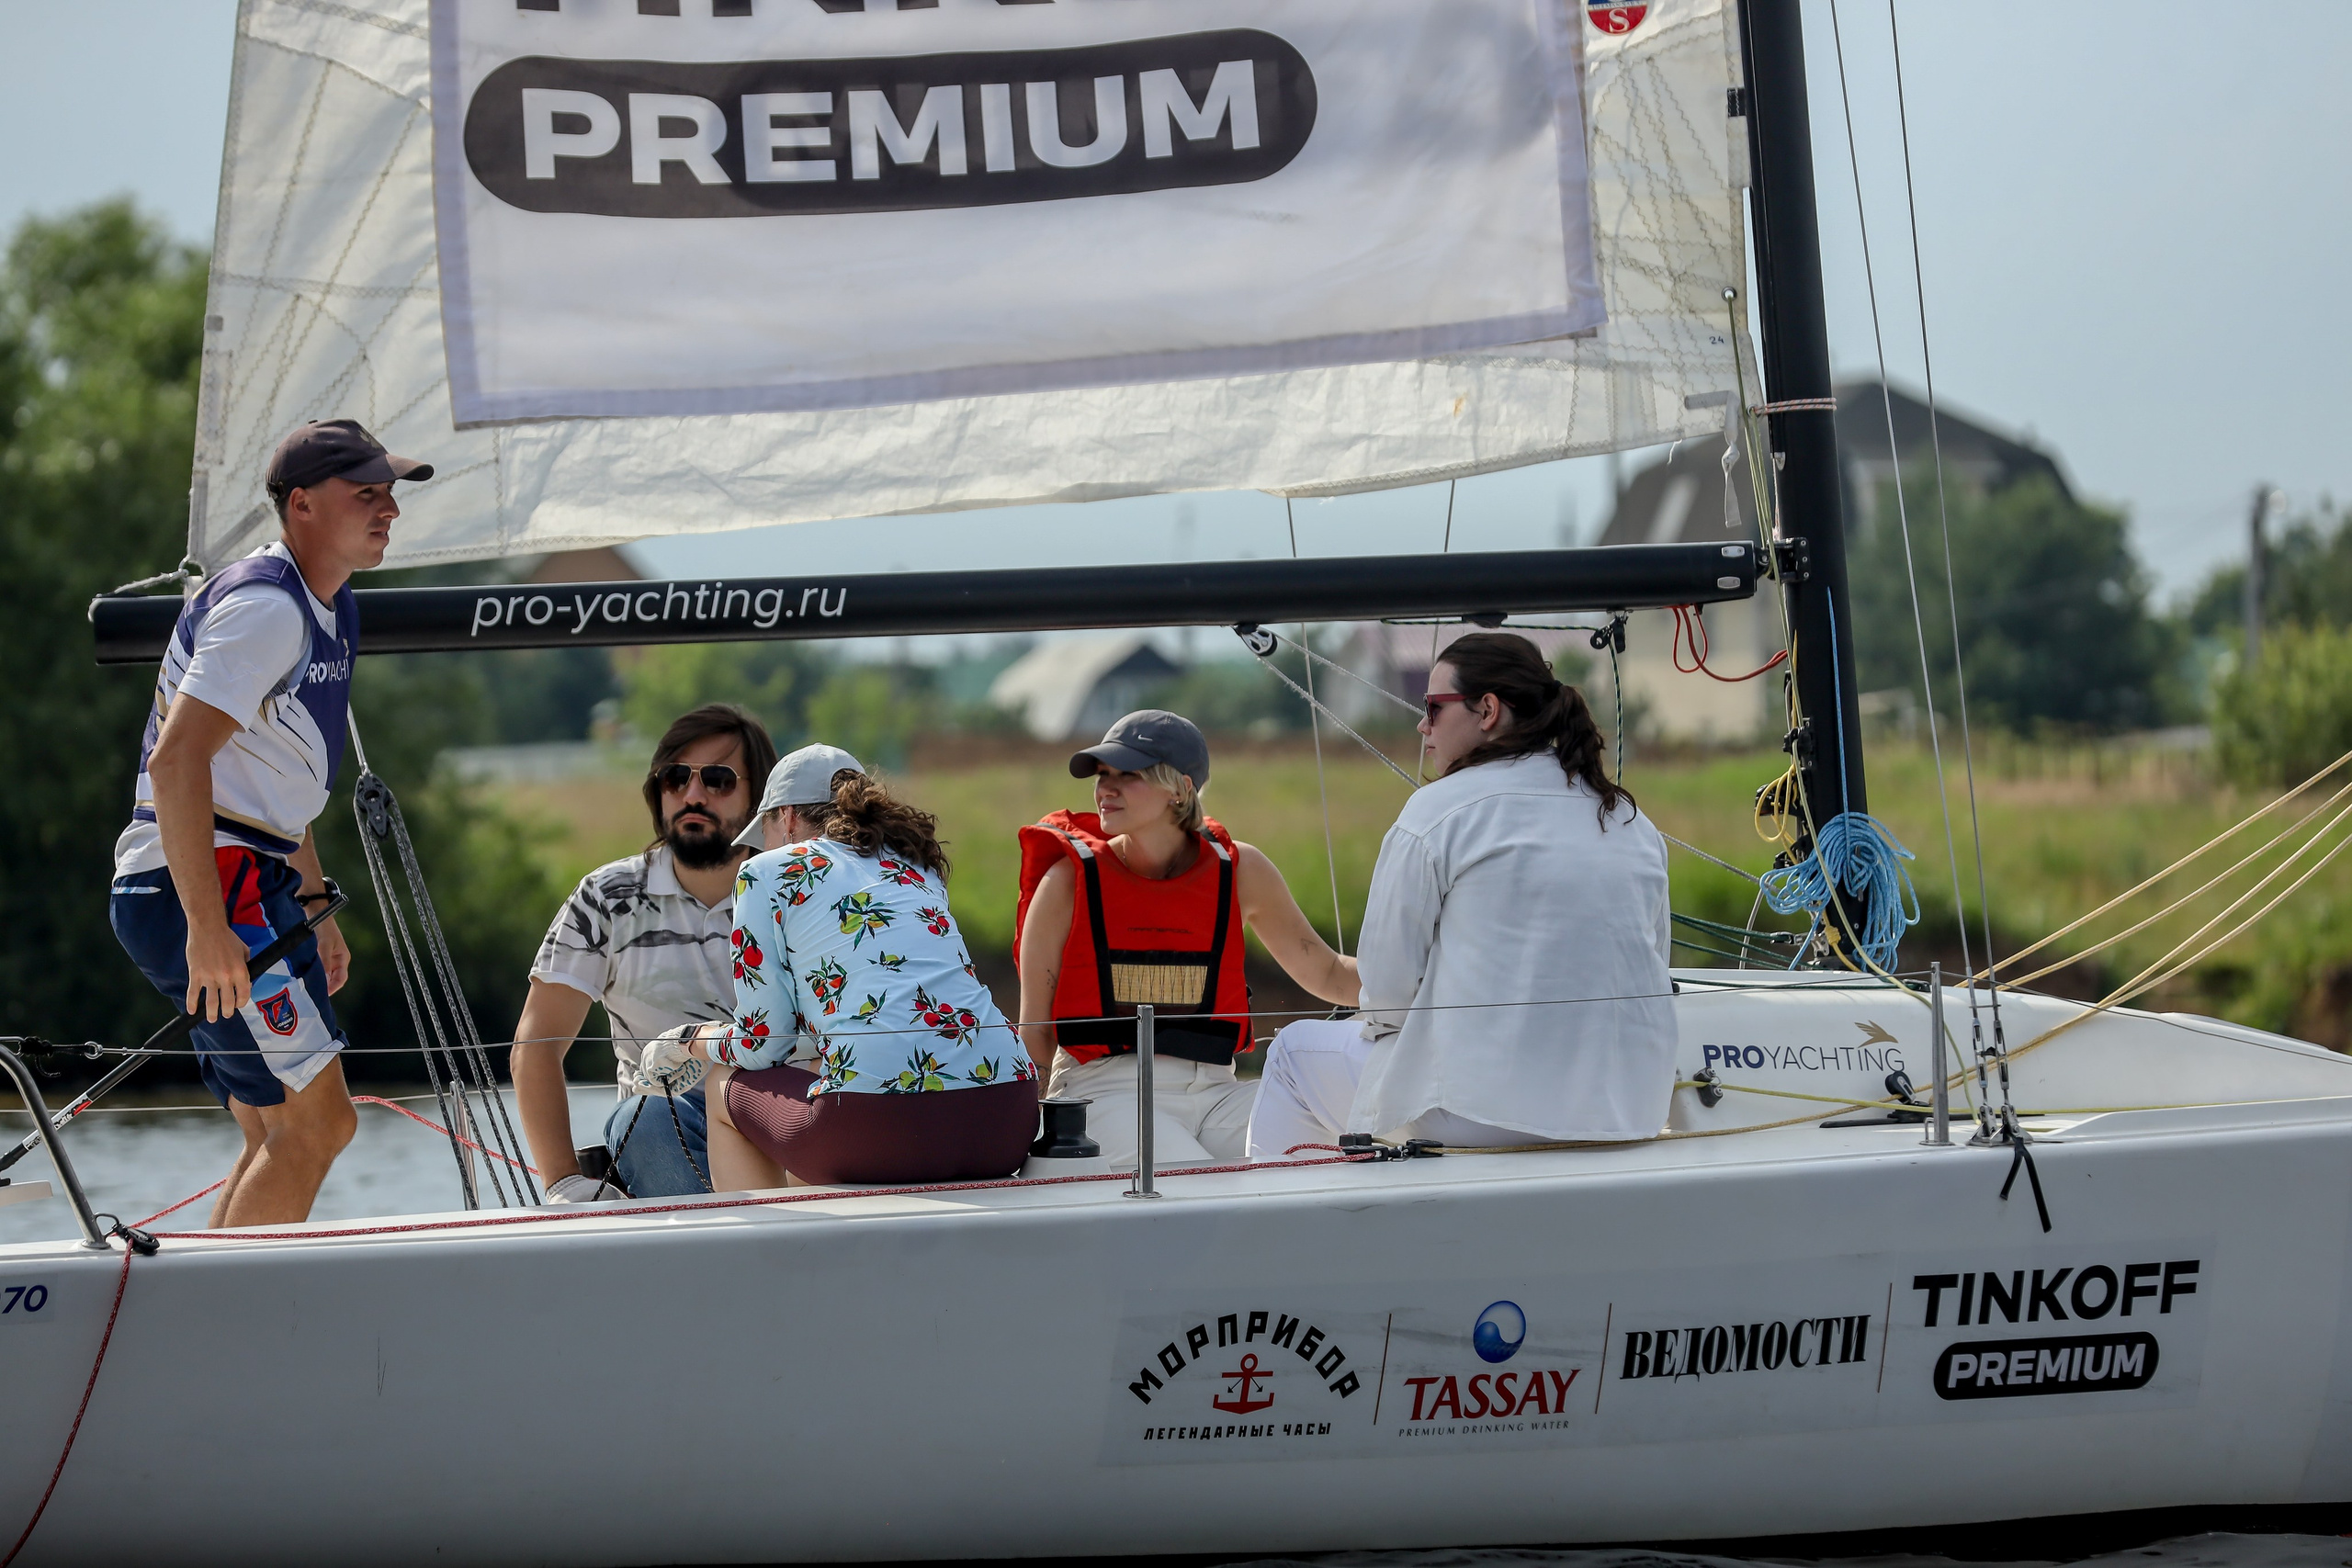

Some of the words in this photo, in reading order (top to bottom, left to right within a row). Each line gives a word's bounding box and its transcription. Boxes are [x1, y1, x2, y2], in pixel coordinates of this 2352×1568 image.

[521, 59, 1260, 184] PREMIUM
[1709, 335, 1724, 344] 24
[470, 581, 847, 637] pro-yachting.ru
[1702, 1043, 1905, 1072] PROYACHTING
[0, 1284, 49, 1314] 70
[1912, 1259, 2200, 1327] TINKOFF
[1128, 1311, 1361, 1405] МОРПРИБОР
[1619, 1314, 1871, 1384] ВЕДОМОСТИ
[1946, 1342, 2147, 1389] PREMIUM
[1404, 1369, 1582, 1421] TASSAY
[1143, 1425, 1275, 1440] ЛЕГЕНДАРНЫЕ
[1283, 1423, 1331, 1436] ЧАСЫ
[1399, 1426, 1456, 1438] PREMIUM
[1462, 1423, 1524, 1435] DRINKING
[1531, 1420, 1570, 1431] WATER
